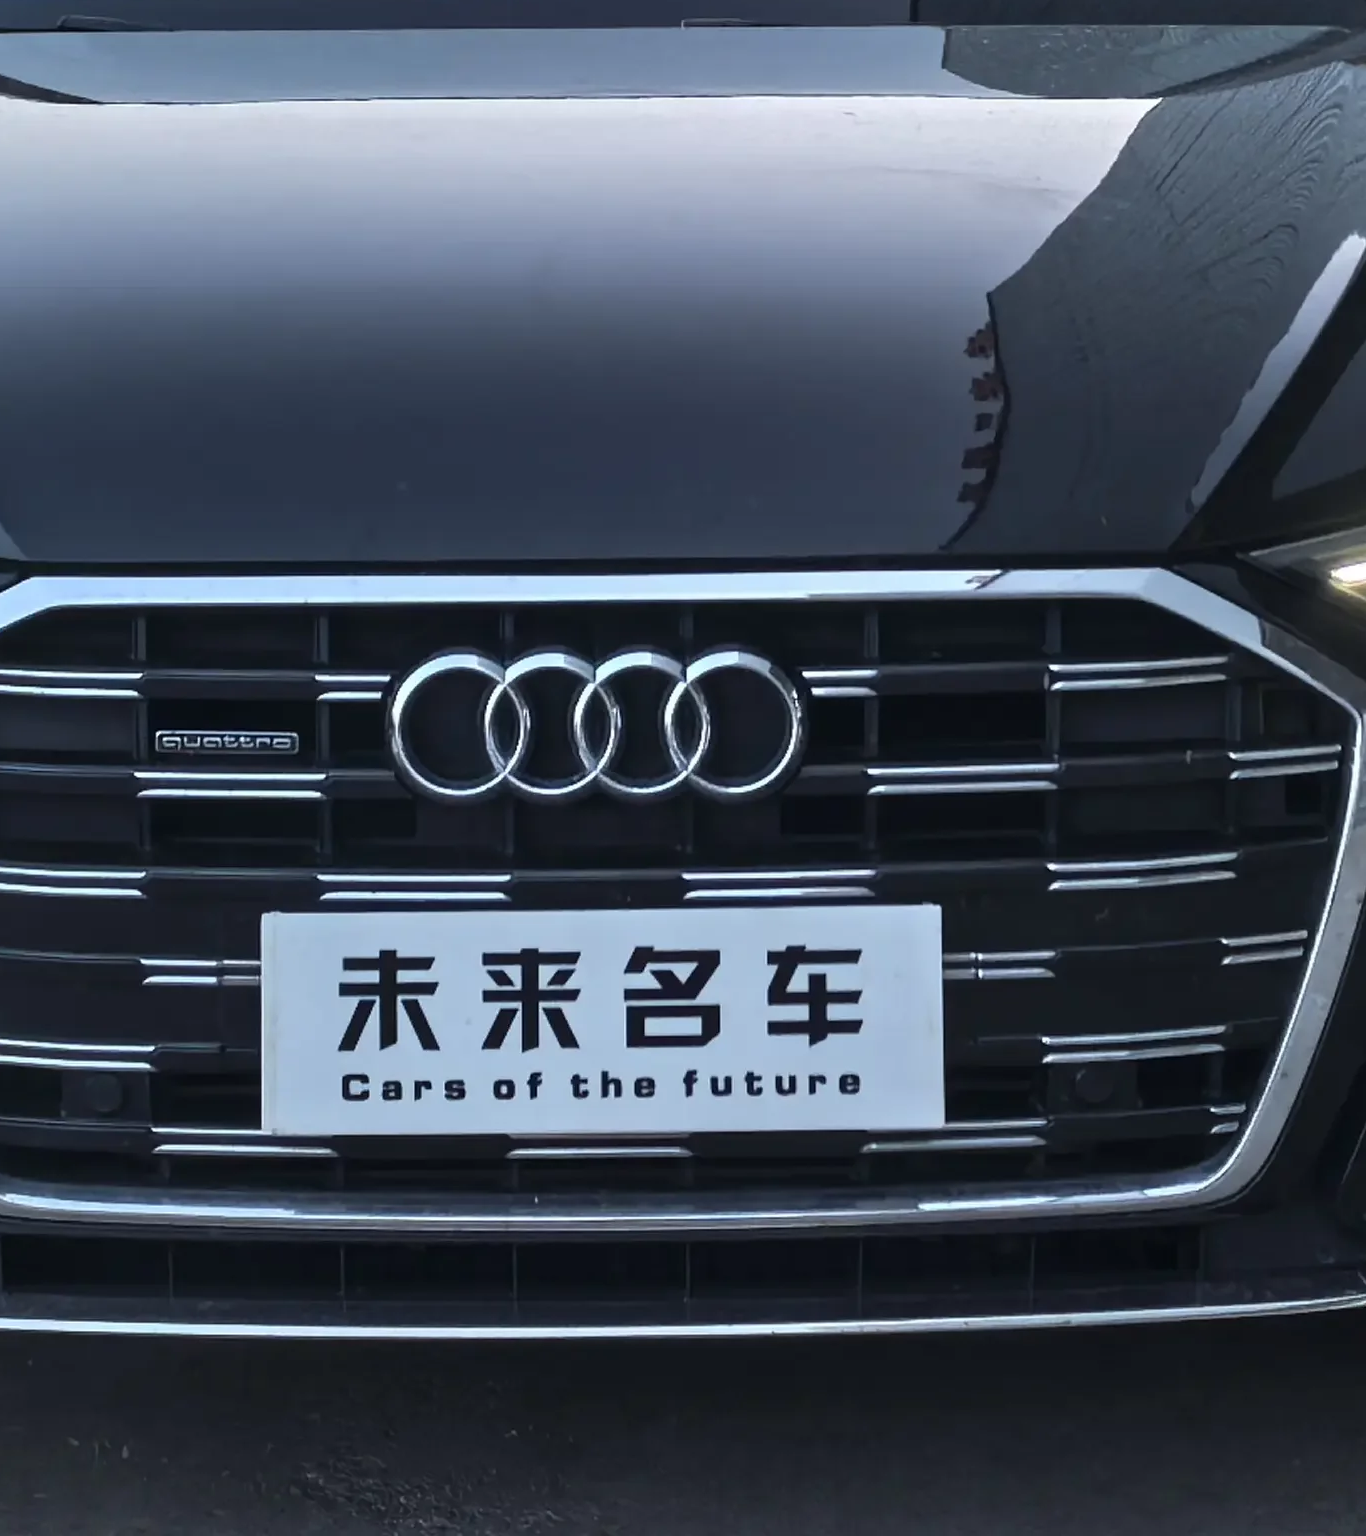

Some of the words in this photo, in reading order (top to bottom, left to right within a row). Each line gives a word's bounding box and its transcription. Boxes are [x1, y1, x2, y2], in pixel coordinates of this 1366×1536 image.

[162, 735, 291, 751] quattro
[338, 946, 863, 1052] 未来名车
[342, 1074, 465, 1101] Cars
[494, 1073, 542, 1099] of
[571, 1071, 655, 1098] the
[683, 1070, 859, 1097] future
